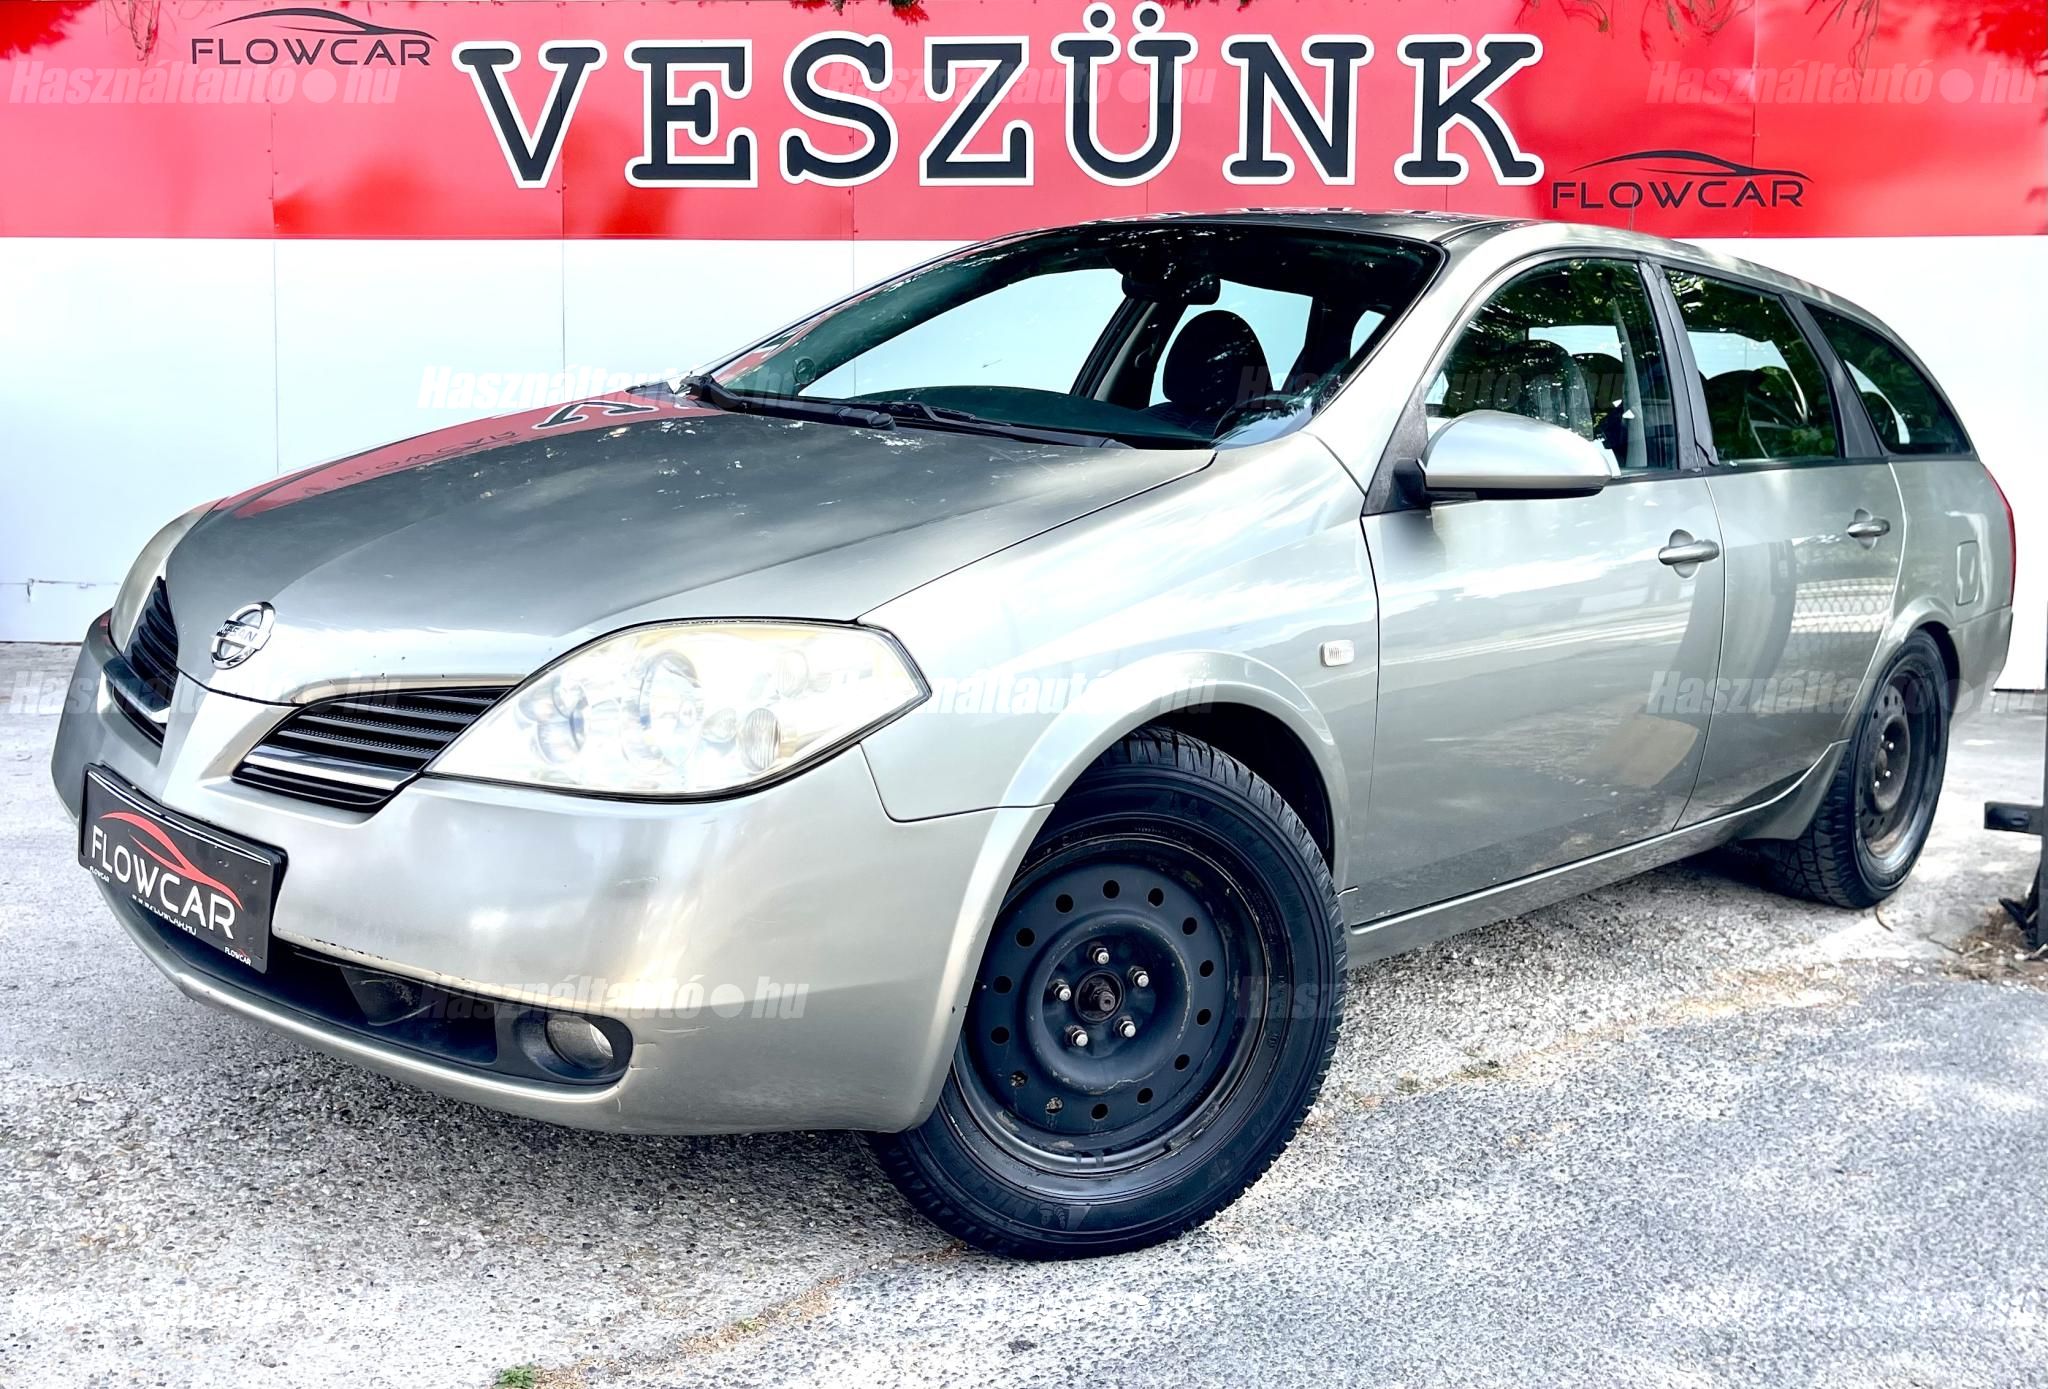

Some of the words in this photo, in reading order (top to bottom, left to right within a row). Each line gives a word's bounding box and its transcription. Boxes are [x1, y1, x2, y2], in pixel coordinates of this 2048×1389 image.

[191, 38, 430, 66] FLOWCAR
[452, 1, 1545, 189] VESZÜNK
[1551, 180, 1805, 209] FLOWCAR
[91, 825, 235, 940] FLOWCAR
